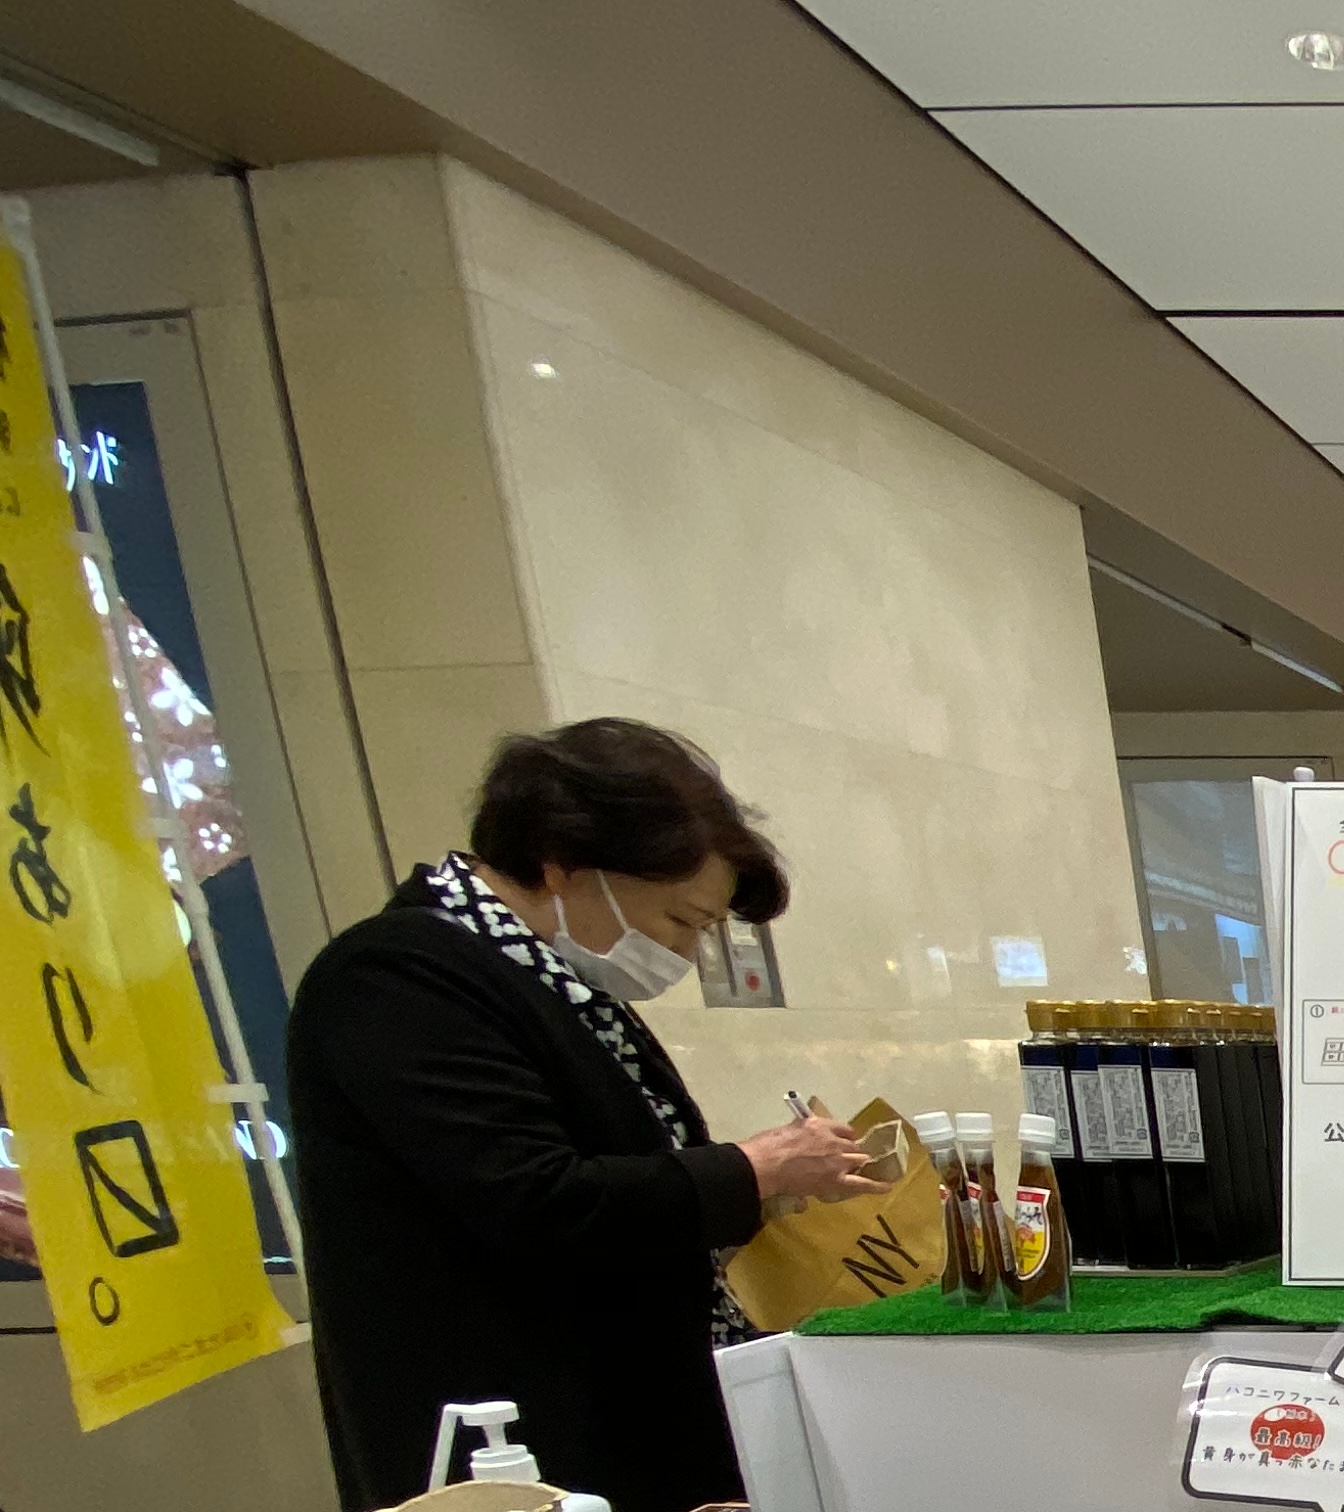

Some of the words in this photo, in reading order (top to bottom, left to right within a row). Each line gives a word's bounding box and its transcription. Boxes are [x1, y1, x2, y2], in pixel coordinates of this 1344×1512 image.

[1225, 1385, 1340, 1406] ハコニワファーム
[1254, 1426, 1322, 1449] 最高級!
